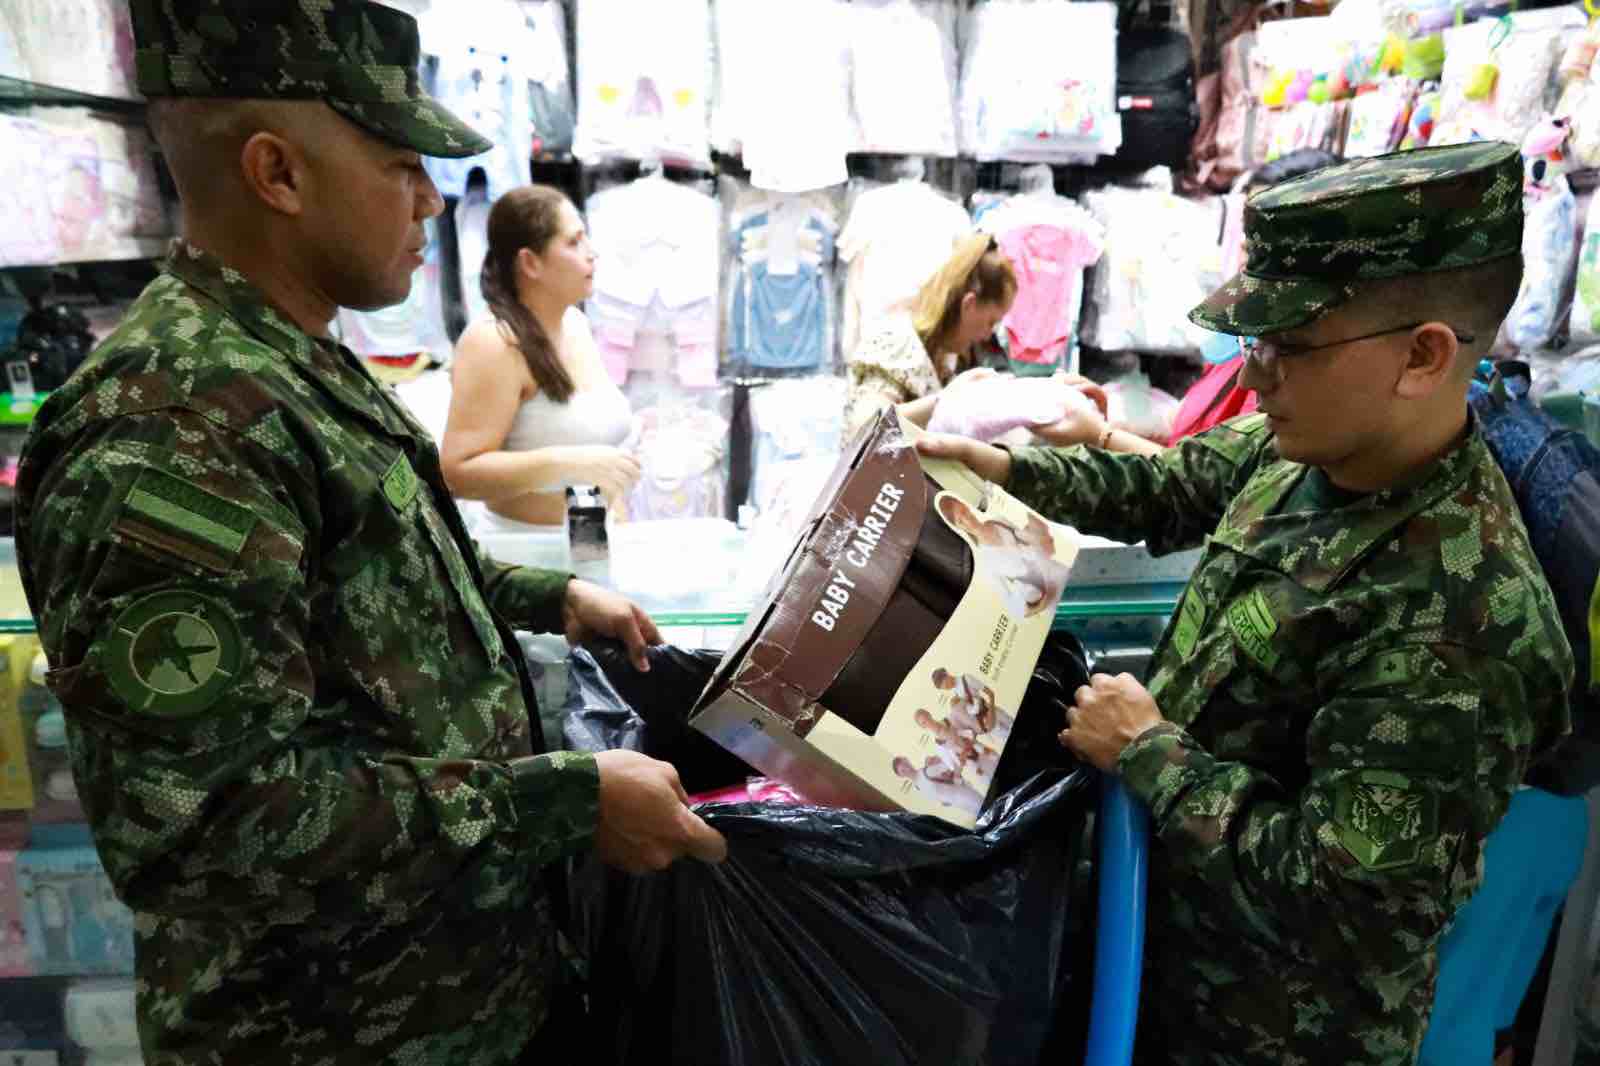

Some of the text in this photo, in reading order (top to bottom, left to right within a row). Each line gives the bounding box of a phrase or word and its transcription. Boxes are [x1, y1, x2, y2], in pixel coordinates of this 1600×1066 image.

[811, 482, 905, 632] BABY CARRIER
[979, 652, 994, 675] BABY
[989, 613, 1009, 650] CARRIER
